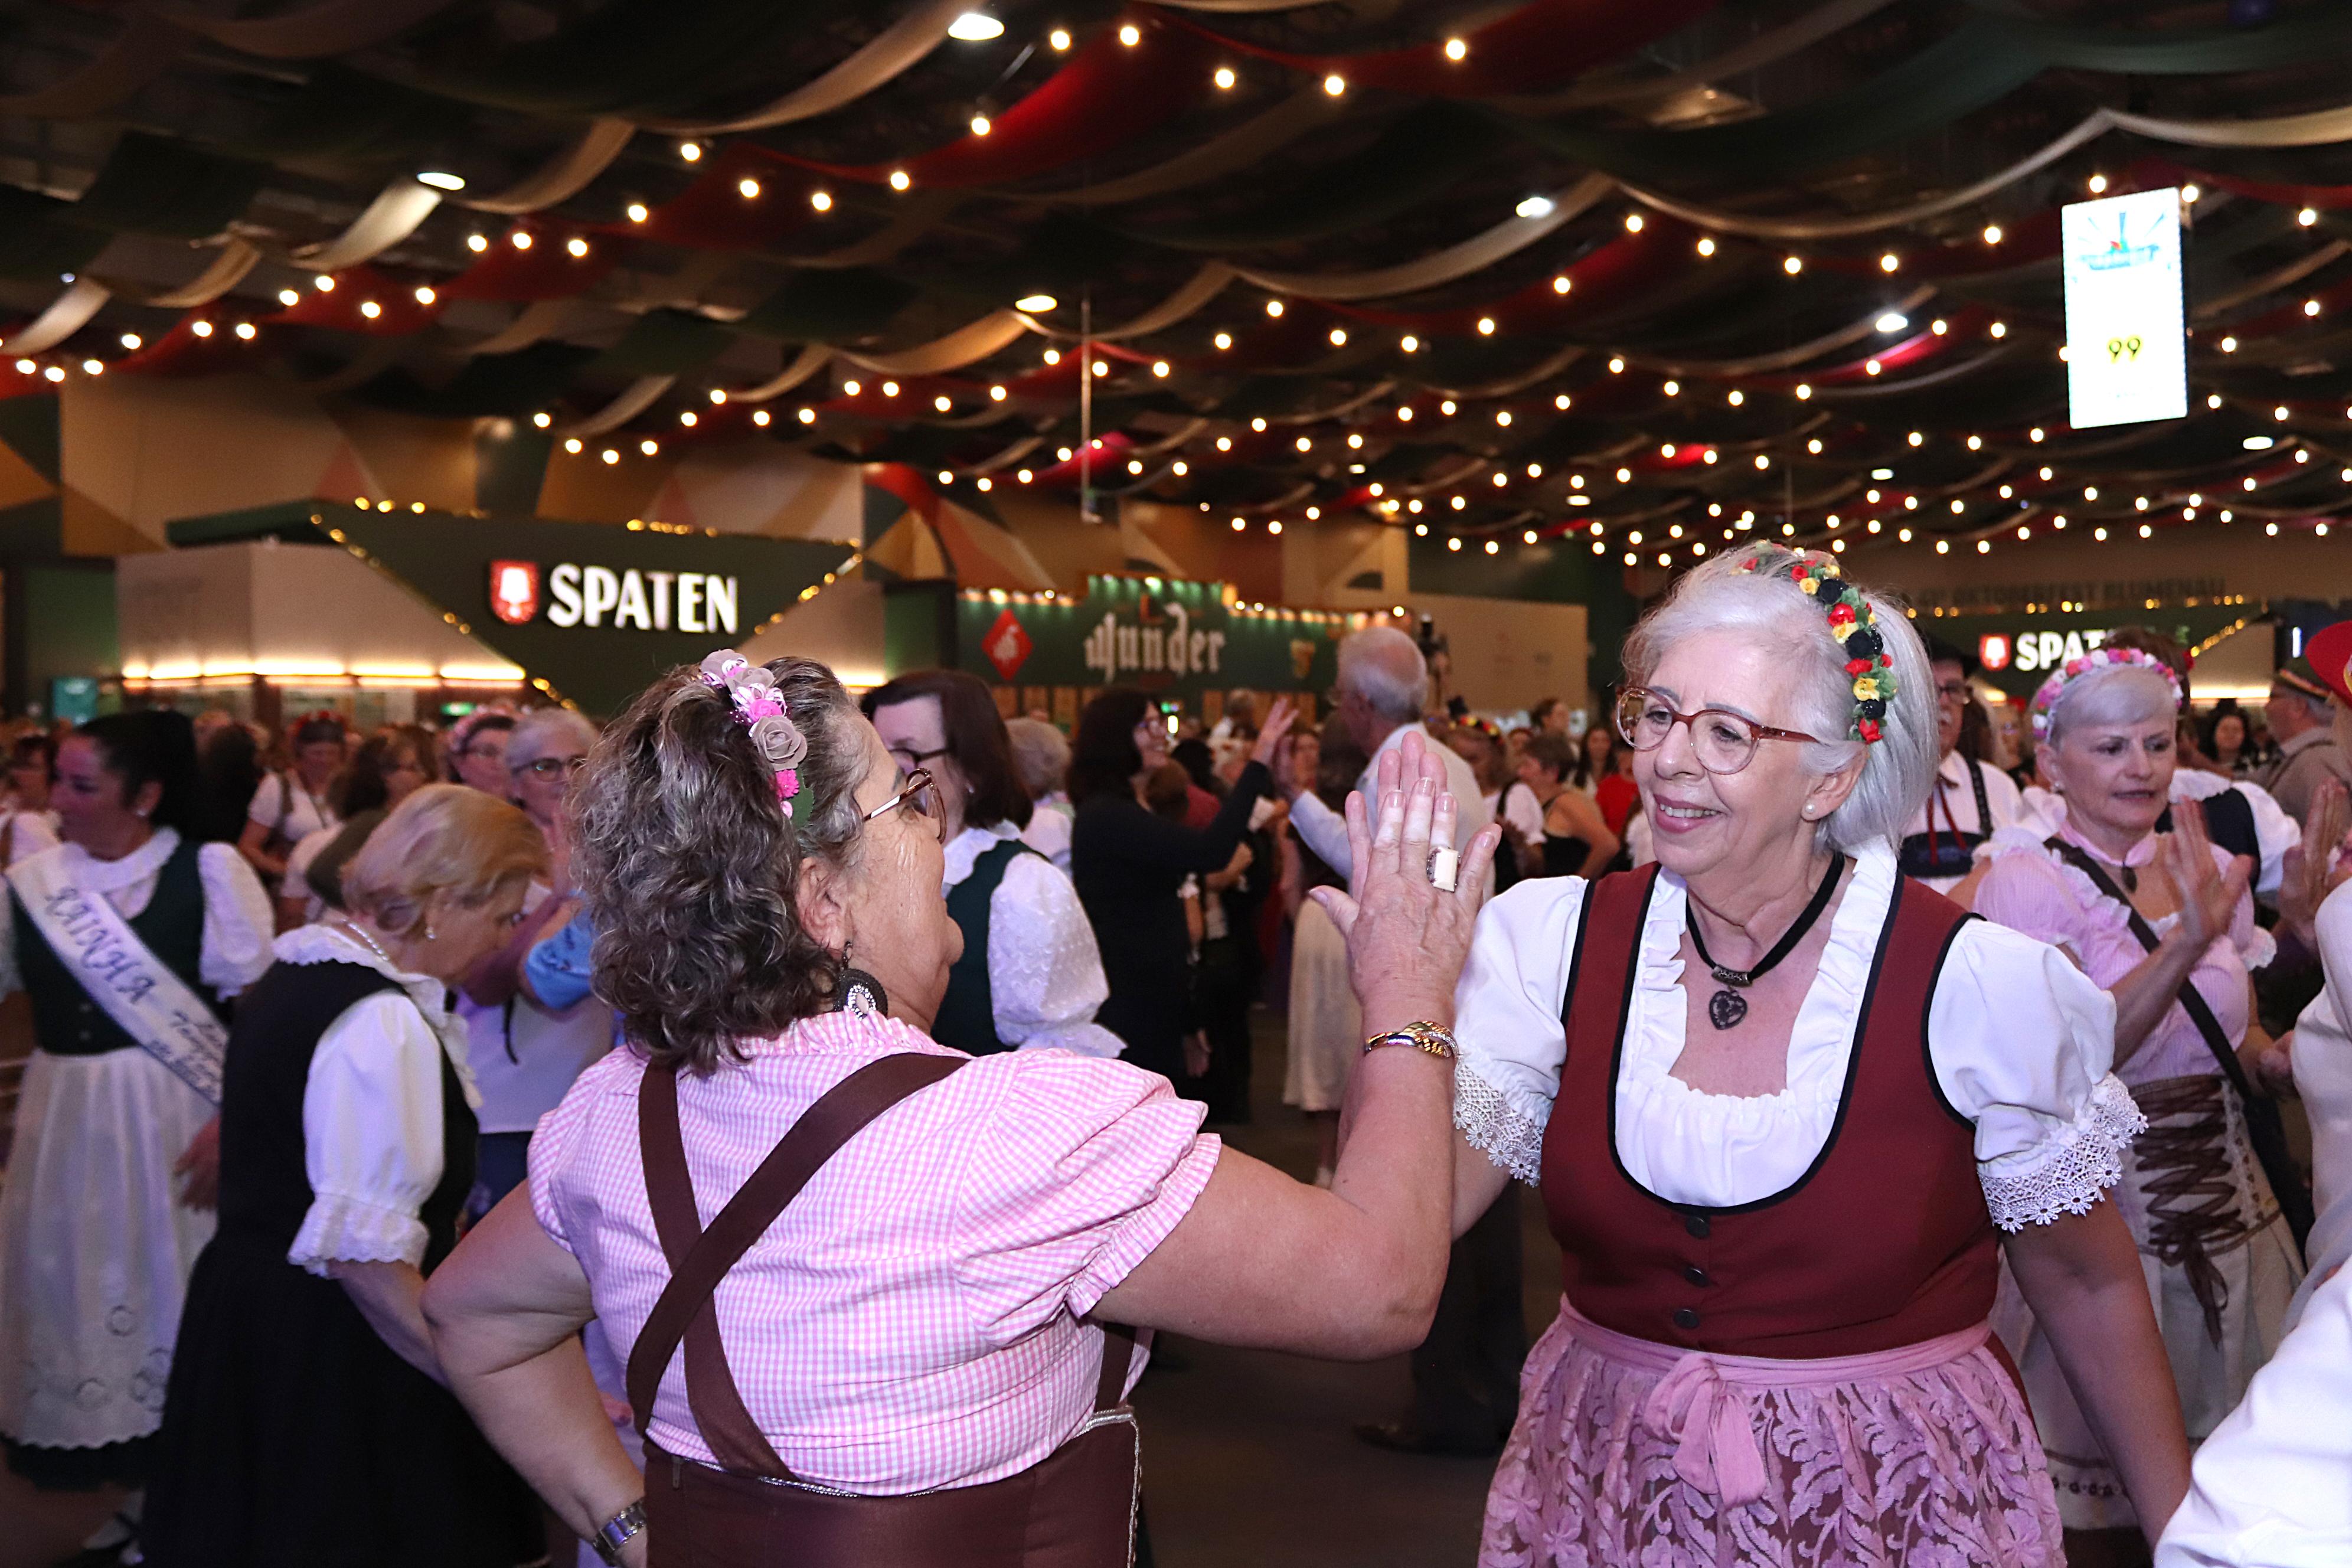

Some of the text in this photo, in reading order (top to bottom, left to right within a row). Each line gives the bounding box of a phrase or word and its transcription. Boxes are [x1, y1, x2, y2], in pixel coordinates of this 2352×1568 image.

[2108, 335, 2144, 364] 99
[547, 563, 738, 635] SPATEN
[2015, 628, 2117, 672] SPAT
